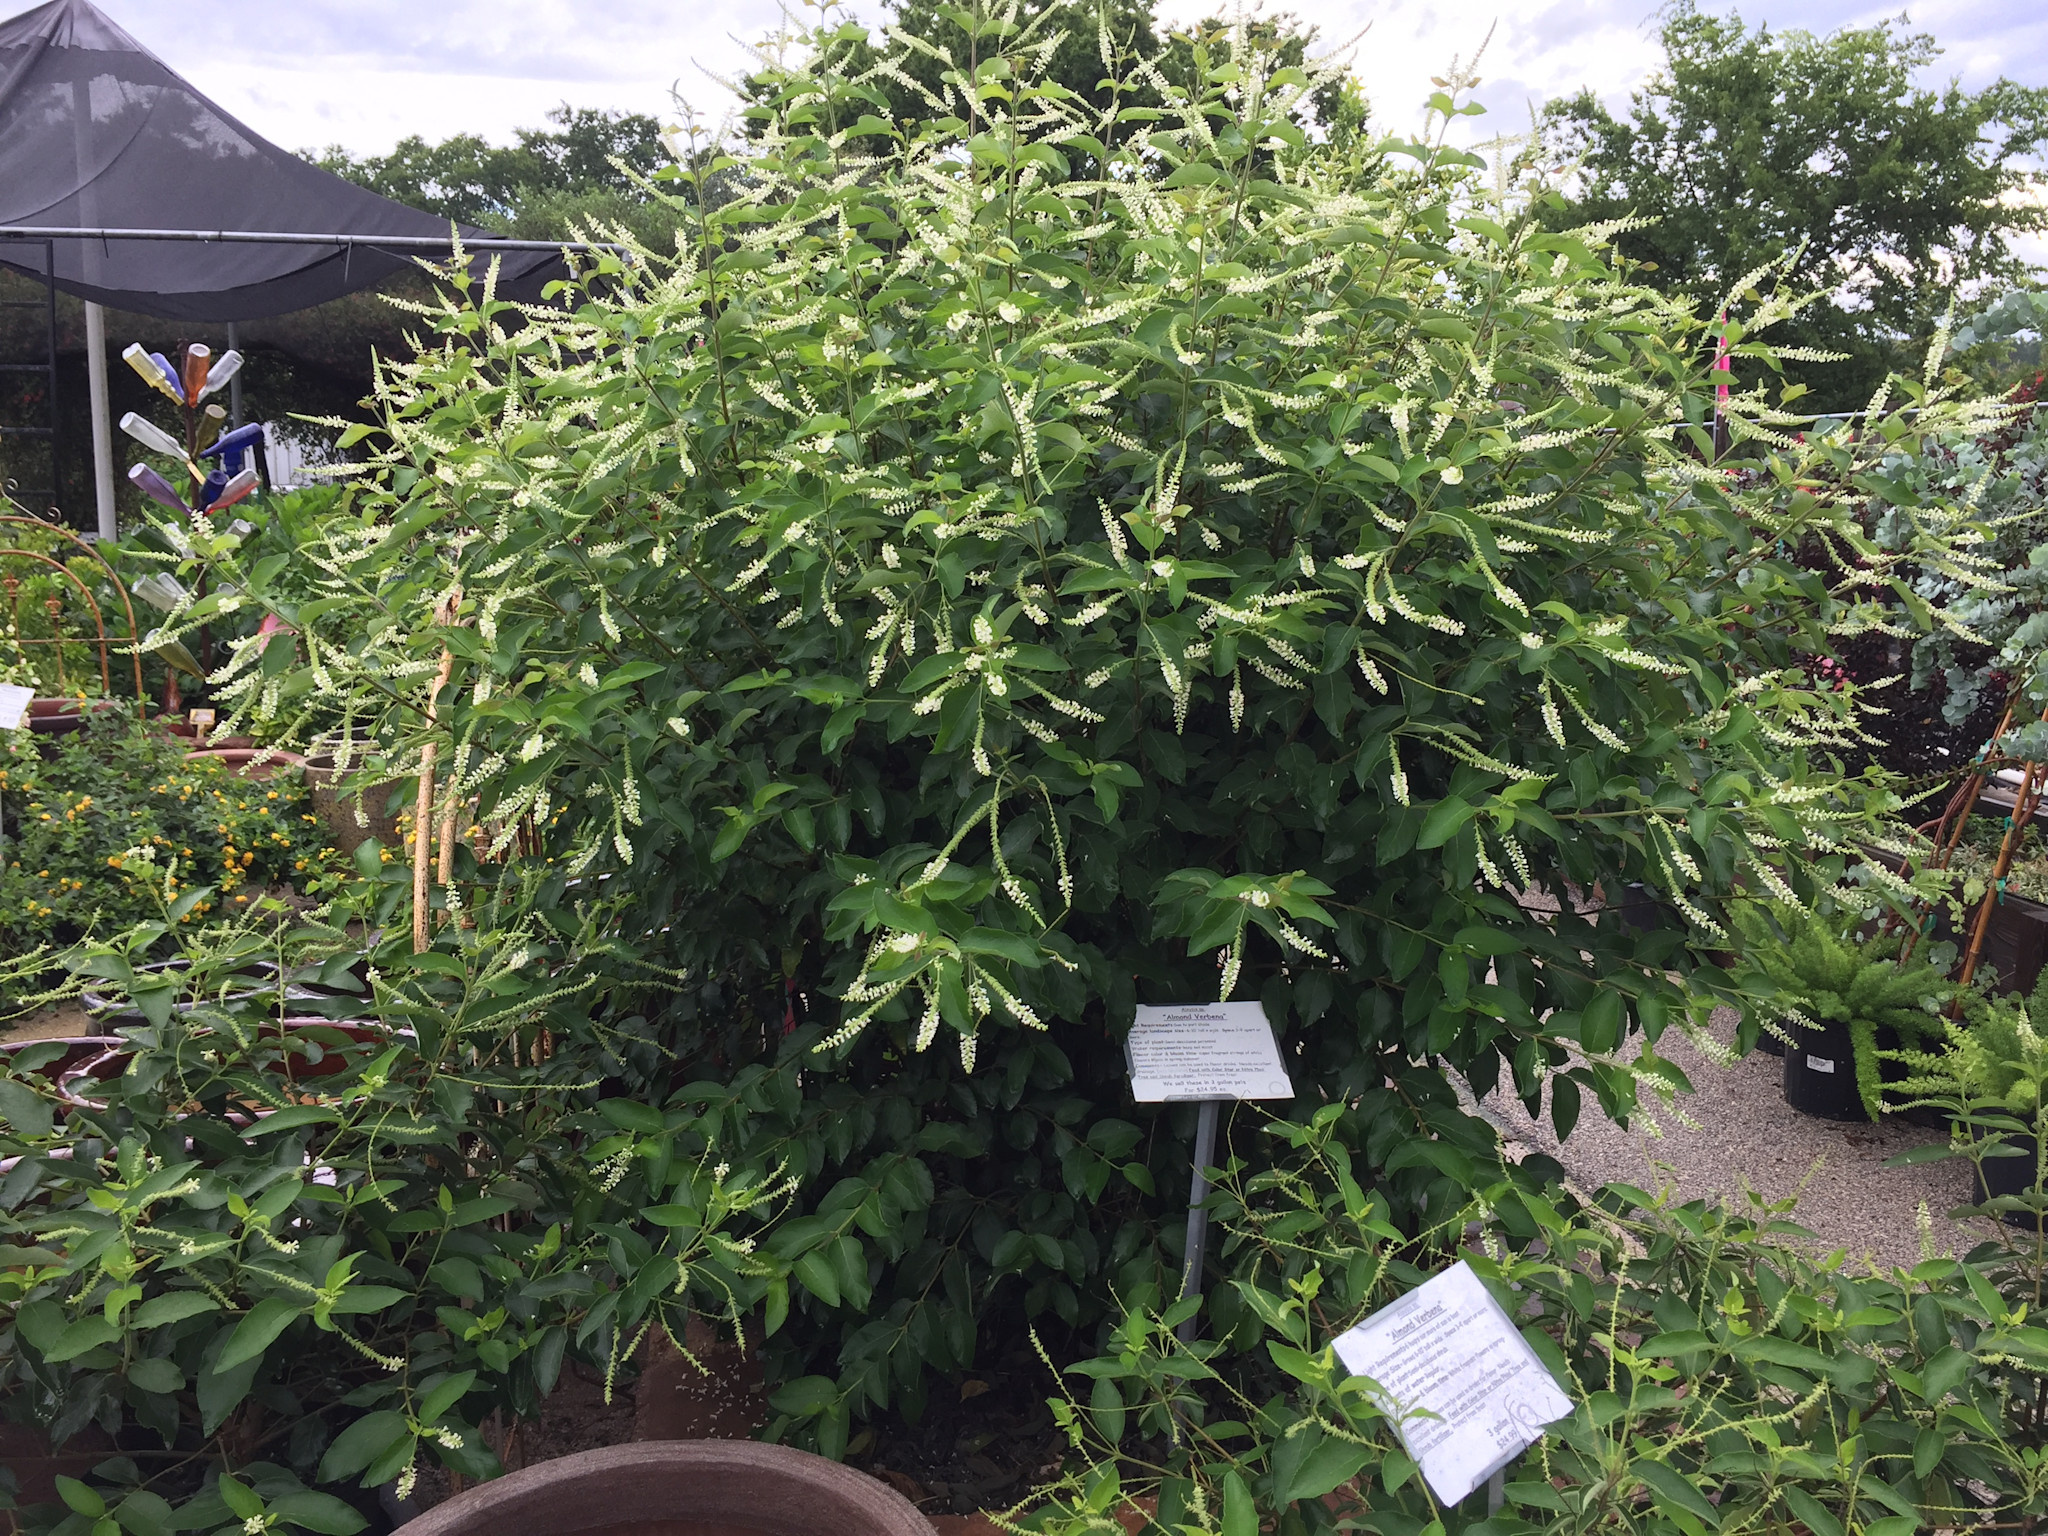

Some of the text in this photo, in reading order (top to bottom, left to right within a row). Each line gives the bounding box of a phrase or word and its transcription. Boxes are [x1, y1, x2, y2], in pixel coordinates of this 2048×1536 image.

[1385, 1299, 1445, 1342] "Almond Verbena"
[1485, 1415, 1511, 1437] 3 gallon
[1495, 1428, 1519, 1450] $24.99
